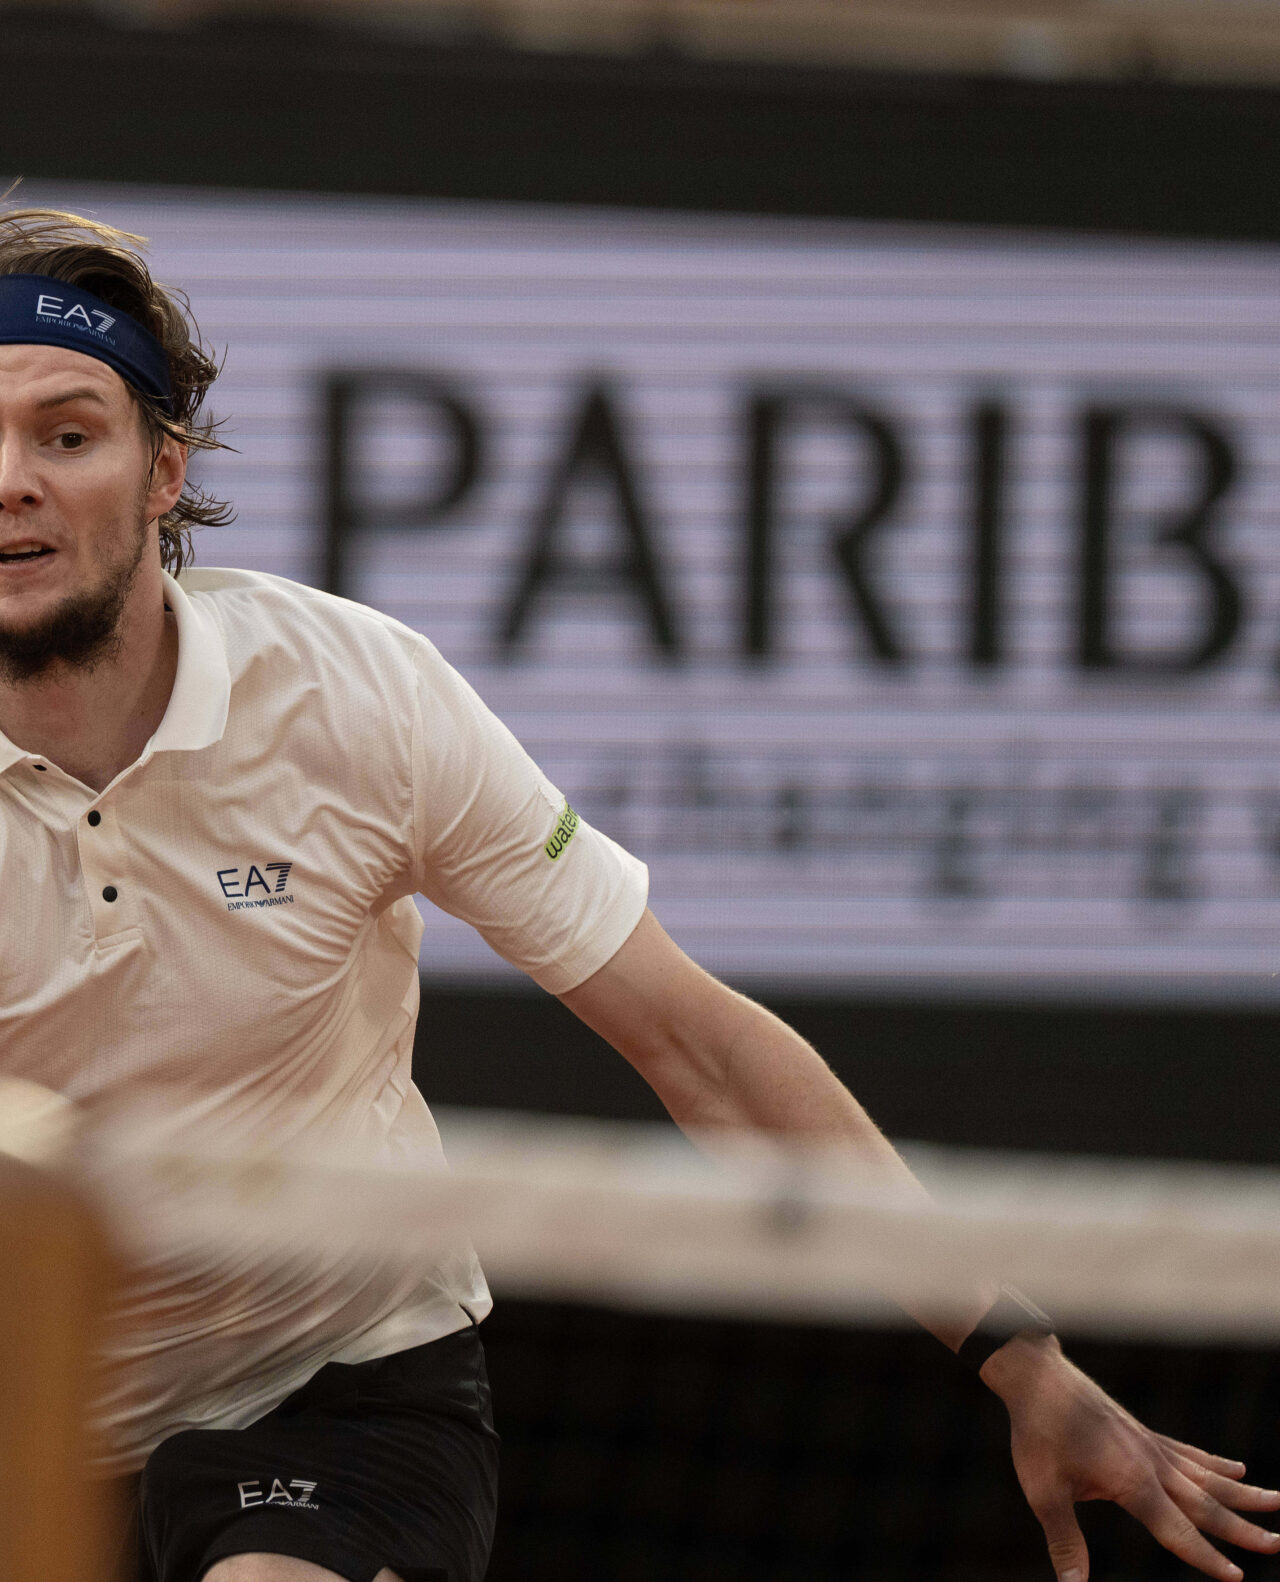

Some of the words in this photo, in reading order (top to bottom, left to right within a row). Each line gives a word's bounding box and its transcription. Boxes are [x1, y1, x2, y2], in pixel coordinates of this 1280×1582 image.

[36, 294, 117, 333] EA7
[314, 362, 1280, 678] PARIB
[545, 803, 579, 860] water
[216, 862, 293, 898] EA7
[237, 1478, 318, 1509] EA7
